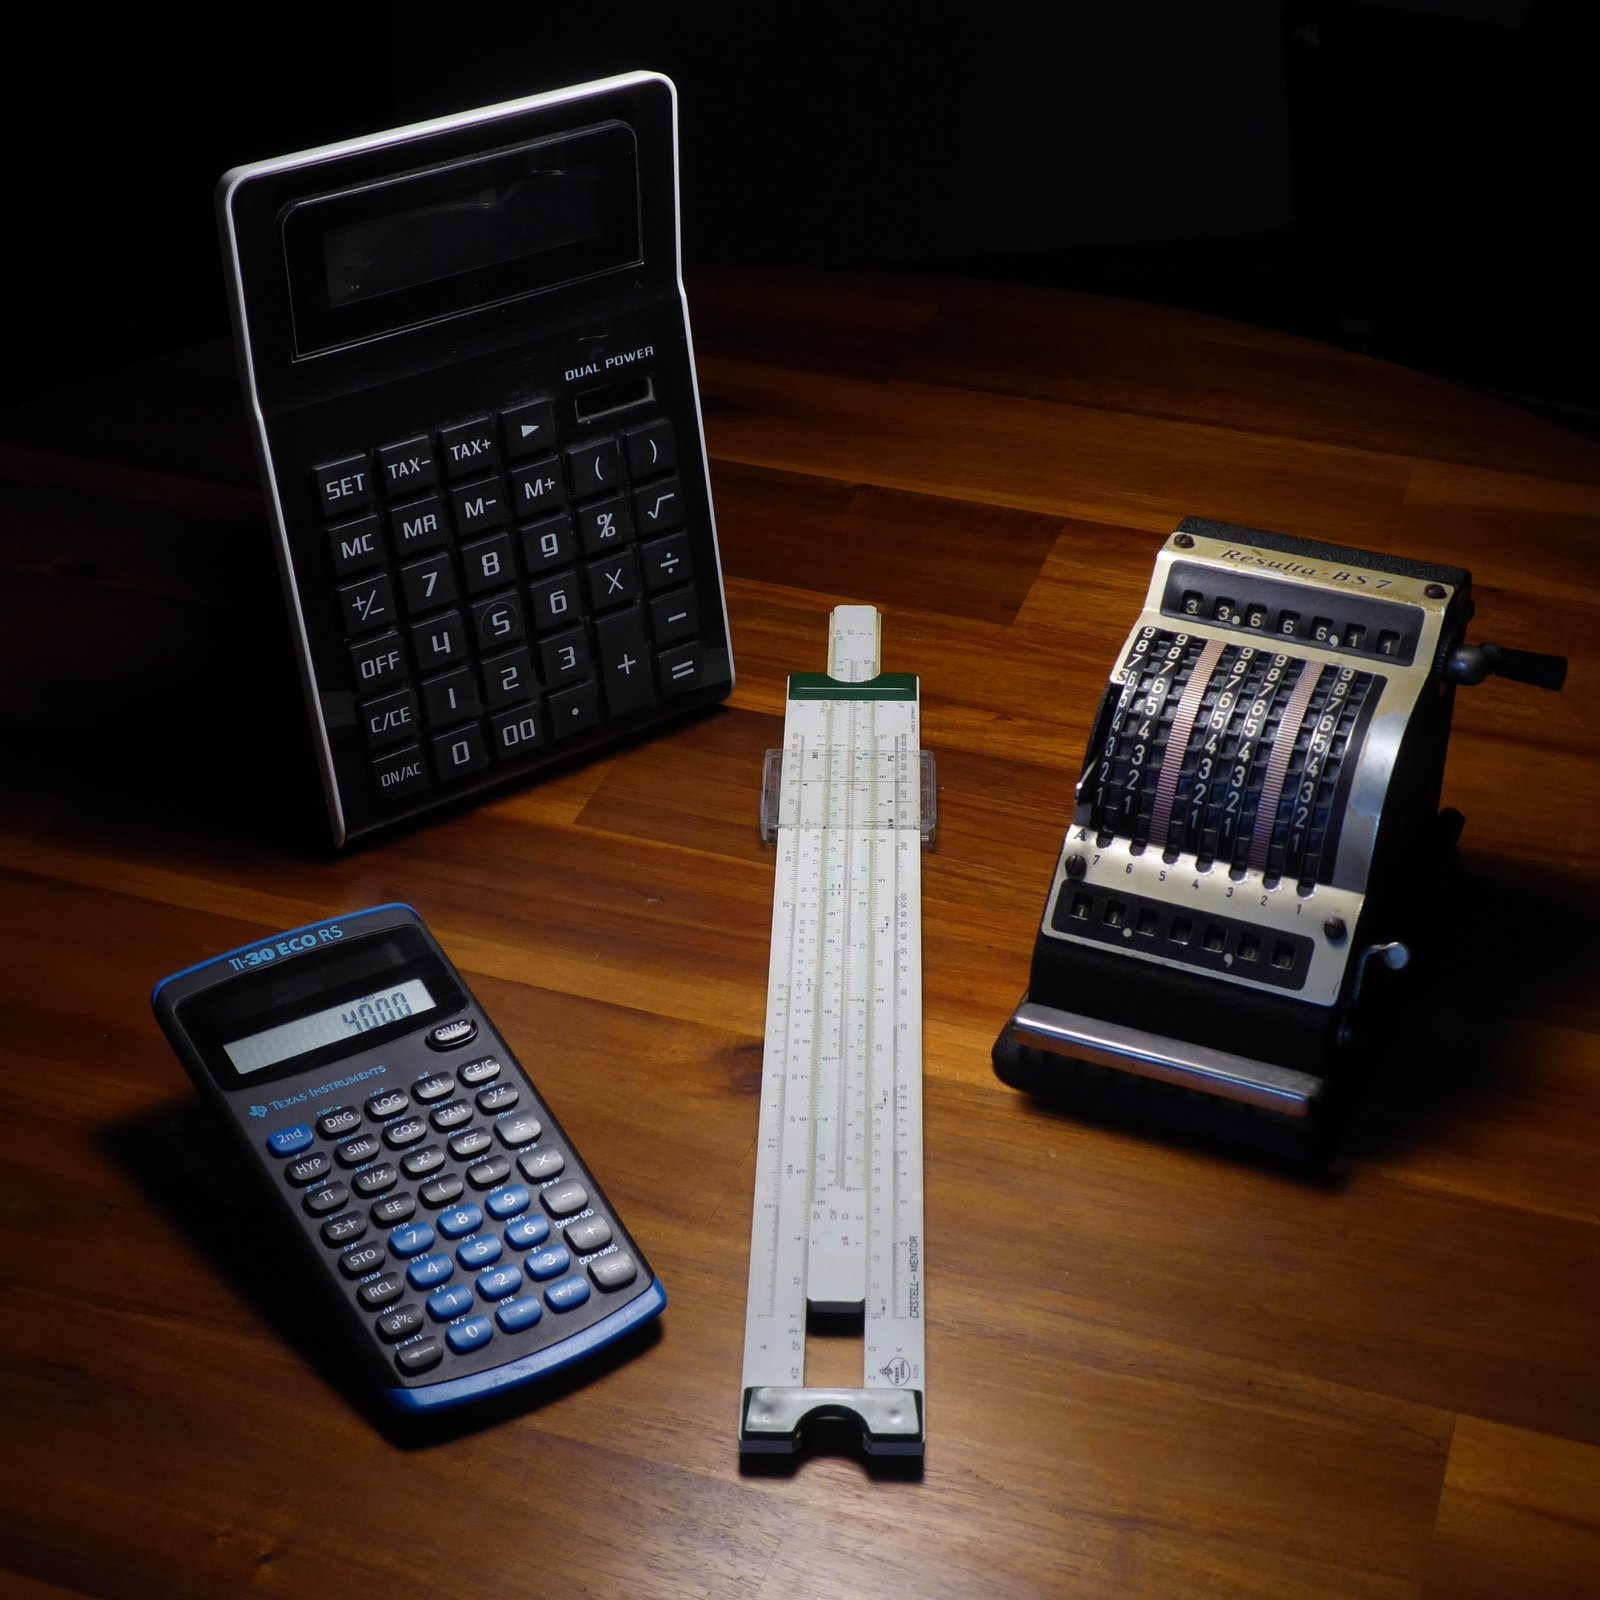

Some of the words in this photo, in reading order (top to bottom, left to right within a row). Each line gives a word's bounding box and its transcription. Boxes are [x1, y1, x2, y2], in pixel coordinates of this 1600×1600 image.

[564, 362, 601, 382] DUAL
[604, 345, 655, 371] POWER
[450, 438, 492, 461] TAX+
[387, 455, 432, 480] TAX-
[326, 473, 365, 500] SET
[523, 477, 556, 499] M+
[464, 497, 498, 519] M-
[402, 513, 438, 539] MR
[596, 512, 617, 539] %
[340, 533, 375, 559] MC
[541, 532, 559, 558] 9
[481, 551, 500, 577] 8
[421, 571, 439, 598] 7
[549, 589, 568, 615] 6
[491, 609, 511, 636] 5
[431, 631, 452, 655] 4
[1143, 627, 1156, 639] 9
[1175, 633, 1189, 646] 9
[1136, 639, 1149, 652] 8
[1168, 646, 1181, 660] 8
[1240, 647, 1254, 660] 9
[360, 649, 401, 680] OFF
[557, 645, 577, 671] 3
[1127, 653, 1143, 667] 7
[1159, 661, 1175, 675] 7
[1233, 660, 1247, 674] 8
[1274, 654, 1288, 668] 9
[499, 665, 520, 692] 2
[1127, 671, 1138, 687] 6
[1225, 675, 1241, 690] 7
[1266, 668, 1281, 682] 8
[1340, 668, 1355, 682] 9
[1152, 677, 1167, 695] 6
[1258, 682, 1275, 698] 7
[1334, 682, 1348, 697] 8
[447, 687, 458, 710] 1
[1119, 690, 1130, 708] 5
[1145, 697, 1160, 716] 5
[1218, 692, 1233, 709] 6
[1251, 699, 1267, 716] 6
[1326, 697, 1343, 713] 7
[369, 705, 412, 735] C/CE
[1112, 714, 1123, 733] 4
[1138, 720, 1151, 740] 4
[1211, 711, 1227, 730] 5
[1244, 719, 1260, 738] 5
[1319, 714, 1335, 732] 6
[501, 717, 536, 748] 00
[452, 740, 471, 766] 0
[1105, 736, 1116, 757] 3
[1204, 734, 1218, 755] 4
[1237, 741, 1251, 763] 4
[1312, 733, 1328, 753] 5
[1131, 744, 1146, 766] 3
[380, 761, 422, 788] ON/AC
[1099, 761, 1110, 782] 2
[1198, 757, 1213, 780] 3
[1231, 765, 1246, 788] 3
[1305, 756, 1320, 778] 4
[1126, 769, 1140, 791] 2
[1096, 787, 1103, 807] 1
[1192, 783, 1207, 805] 2
[1225, 791, 1240, 813] 2
[1300, 781, 1314, 804] 3
[1124, 795, 1132, 815] 1
[1191, 809, 1199, 829] 1
[1224, 817, 1232, 837] 1
[1294, 806, 1309, 829] 2
[1073, 828, 1087, 842] A
[1292, 833, 1300, 852] 1
[1093, 854, 1101, 866] 7
[1125, 863, 1134, 875] 6
[1158, 870, 1167, 882] 5
[1191, 878, 1200, 890] 4
[1225, 886, 1234, 898] 3
[1260, 895, 1268, 907] 2
[228, 946, 277, 973] TI-30
[278, 932, 319, 958] ECO
[319, 924, 345, 943] RS
[434, 1019, 472, 1040] ON/AC
[464, 1058, 497, 1077] CE/C
[269, 1092, 307, 1111] TEXAS
[308, 1064, 388, 1099] INSTRUMENTS
[425, 1077, 445, 1094] LN
[372, 1093, 402, 1111] LOG
[439, 1103, 466, 1121] TAN
[324, 1110, 355, 1129] DRG
[392, 1120, 420, 1138] COS
[276, 1128, 304, 1145] 2nd
[346, 1139, 371, 1156] SIN
[294, 1157, 322, 1176] HYP
[384, 1199, 404, 1215] EE
[503, 1192, 517, 1207] 9
[455, 1210, 469, 1225] 8
[404, 1229, 418, 1245] 7
[523, 1221, 537, 1235] 6
[350, 1248, 377, 1268] STO
[474, 1241, 489, 1256] 5
[909, 1235, 920, 1273] MENTOR
[426, 1260, 440, 1275] 4
[542, 1252, 557, 1267] 3
[369, 1279, 396, 1299] RCL
[494, 1272, 510, 1287] 2
[445, 1292, 459, 1307] 1
[909, 1281, 920, 1319] CASTELL
[464, 1324, 479, 1339] 0
